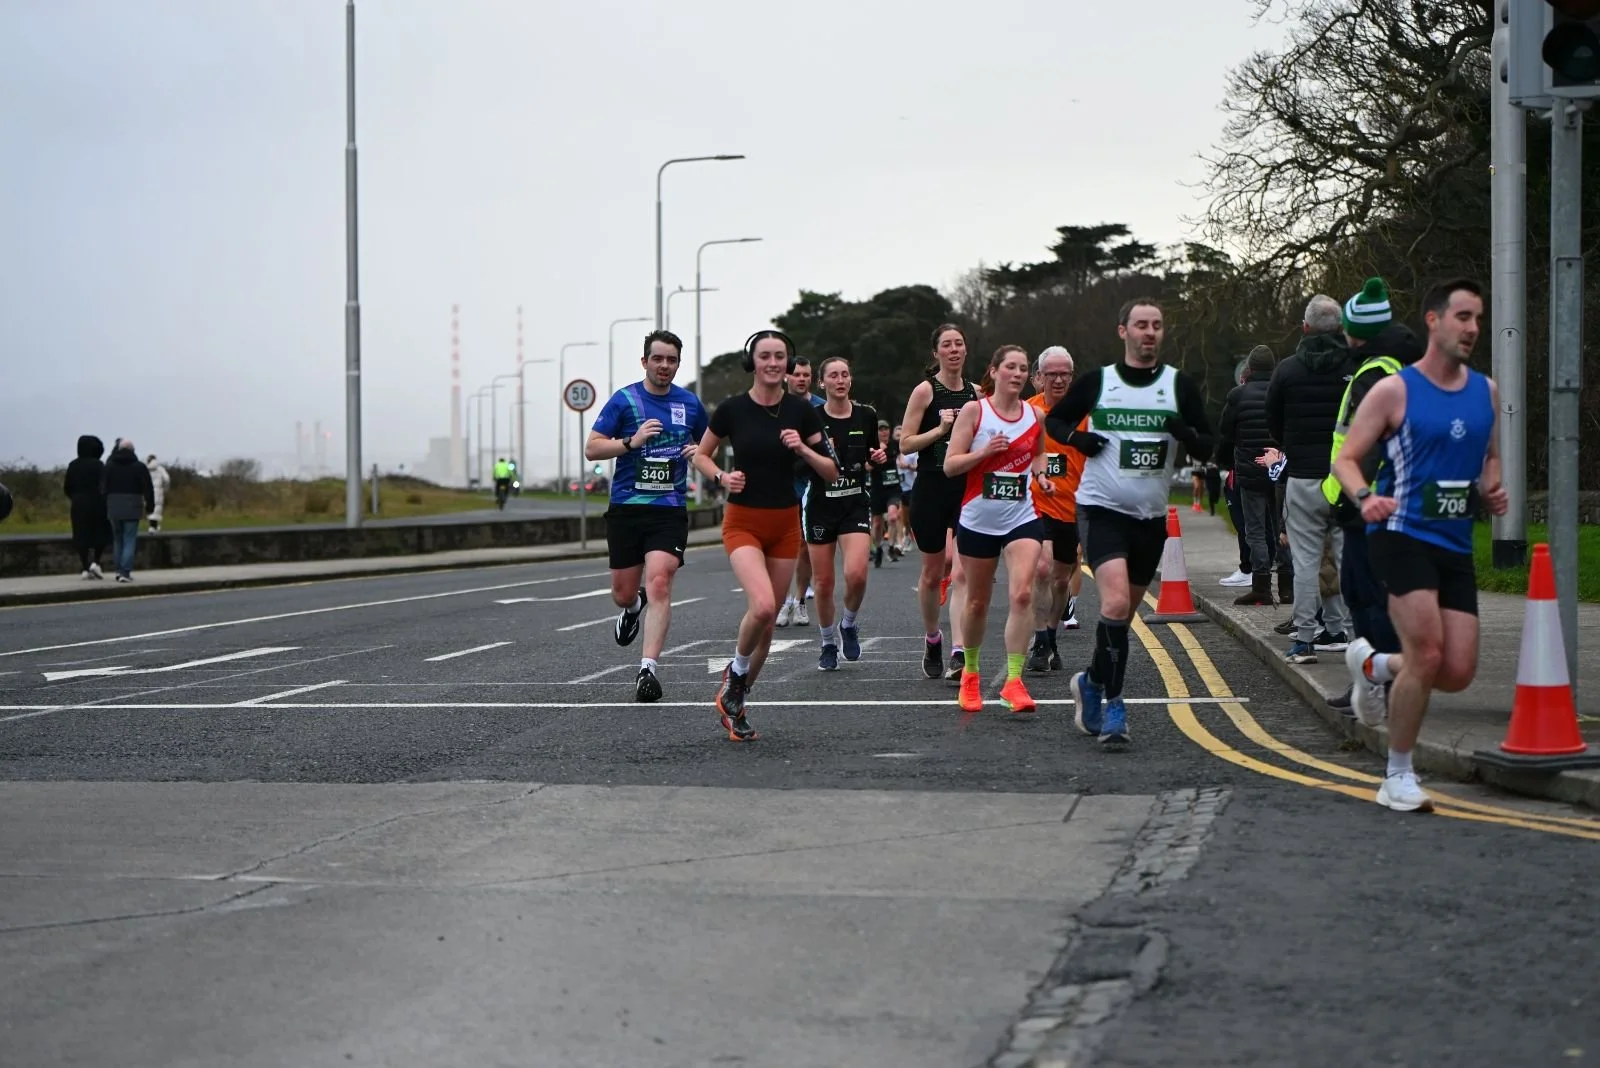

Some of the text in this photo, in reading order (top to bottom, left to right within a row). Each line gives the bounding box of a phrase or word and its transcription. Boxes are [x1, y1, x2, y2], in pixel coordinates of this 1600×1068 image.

[572, 386, 588, 401] 50
[1106, 413, 1166, 427] RAHENY
[1013, 452, 1031, 466] CLUB
[1131, 453, 1159, 466] 305
[641, 469, 670, 480] 3401
[991, 484, 1020, 497] 1421
[1437, 498, 1467, 514] 708
